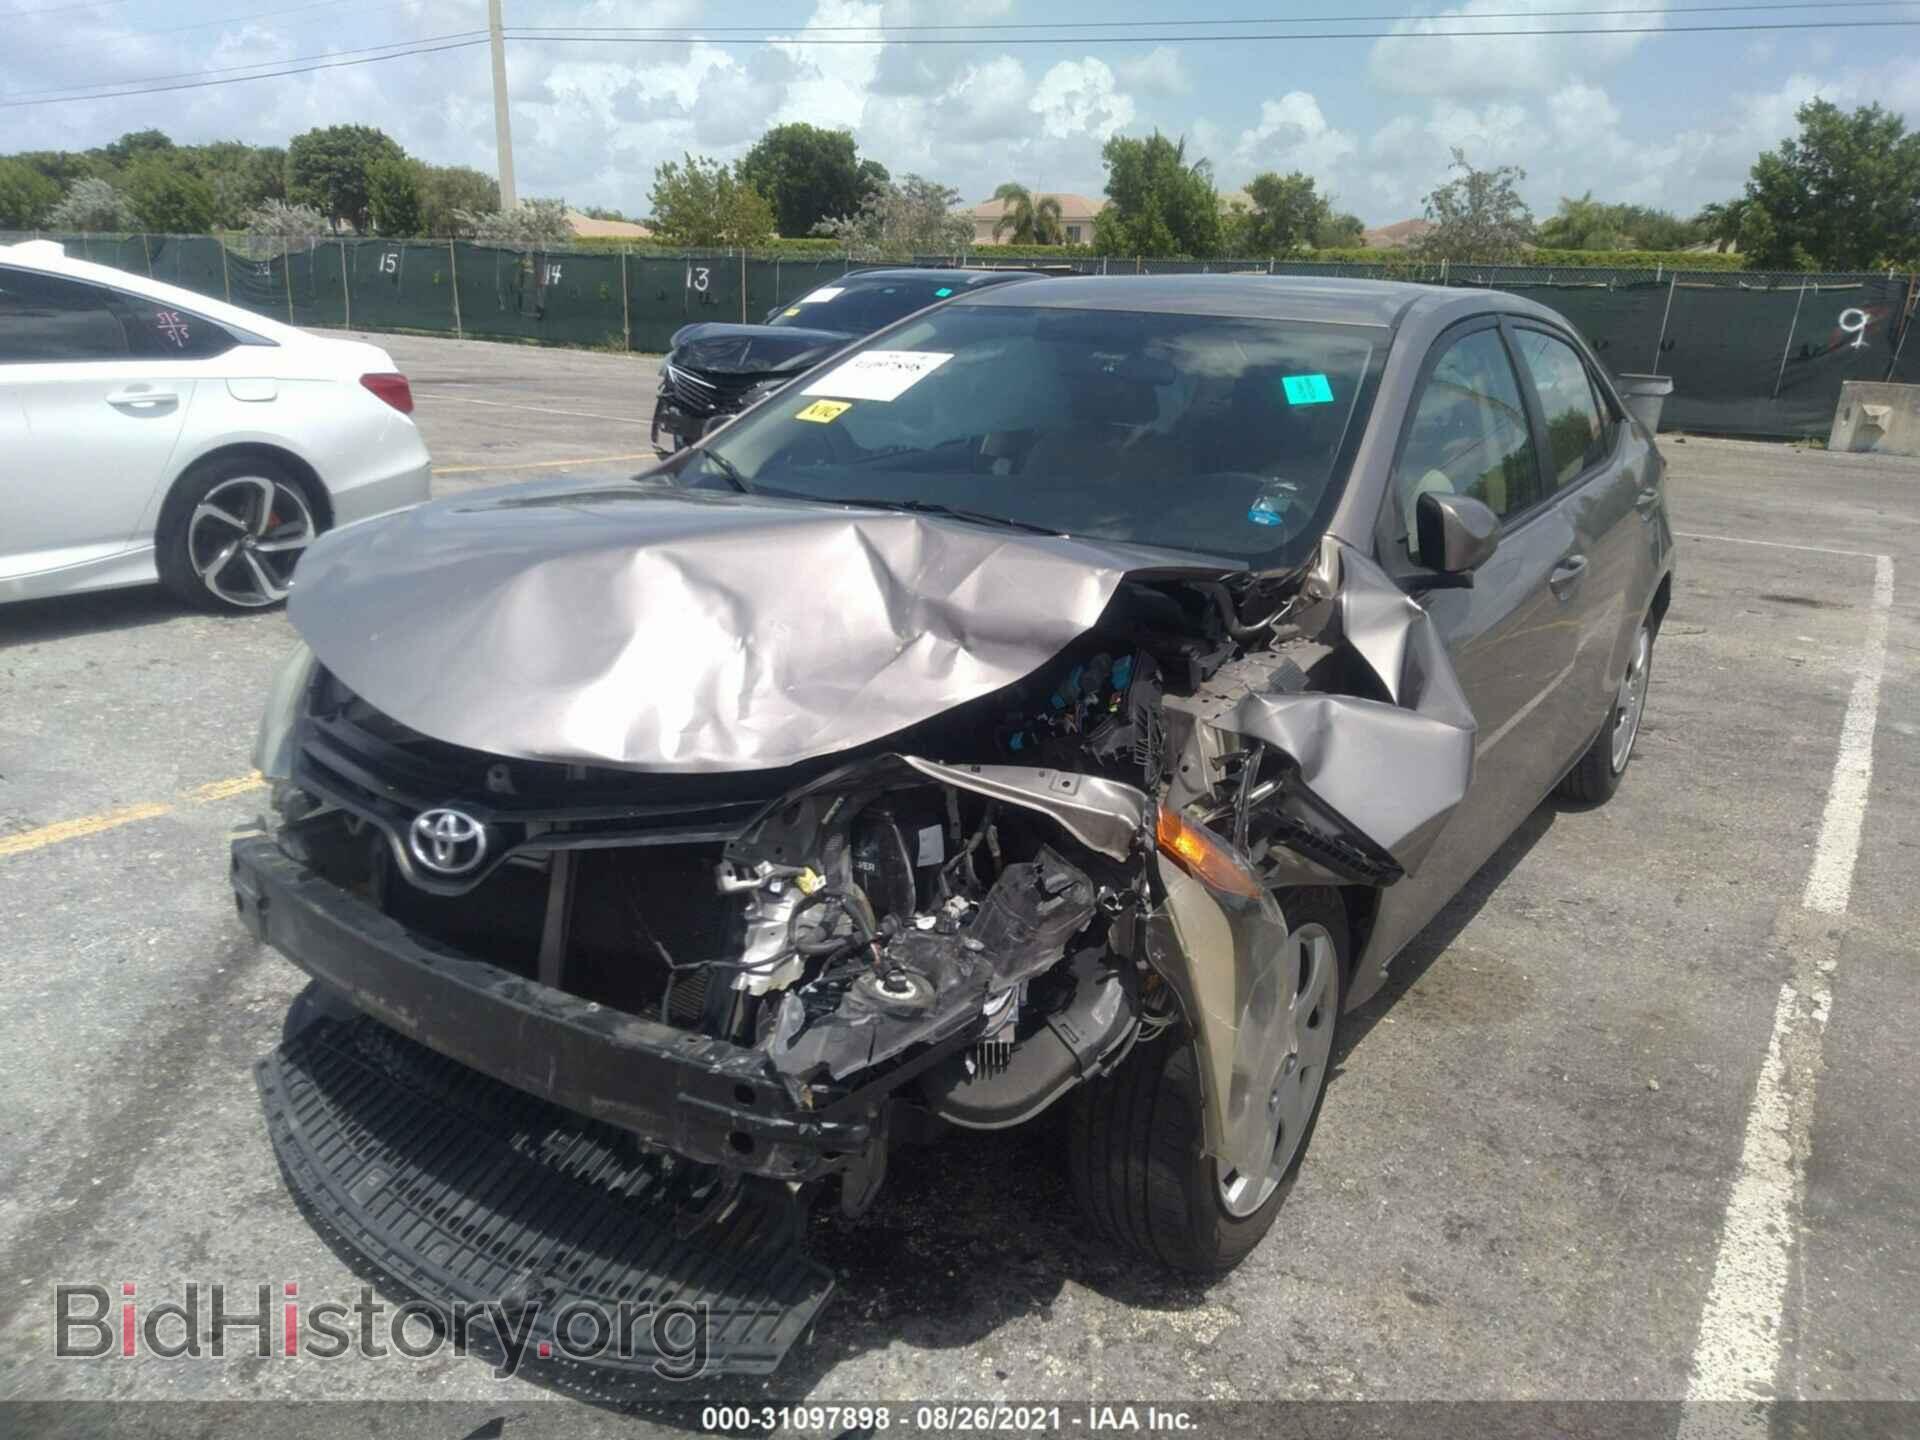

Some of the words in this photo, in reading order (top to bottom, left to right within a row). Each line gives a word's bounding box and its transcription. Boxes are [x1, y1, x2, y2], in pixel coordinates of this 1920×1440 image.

[378, 253, 398, 273] 15
[543, 263, 563, 285] 14
[686, 266, 710, 291] 13
[1839, 307, 1870, 349] 9
